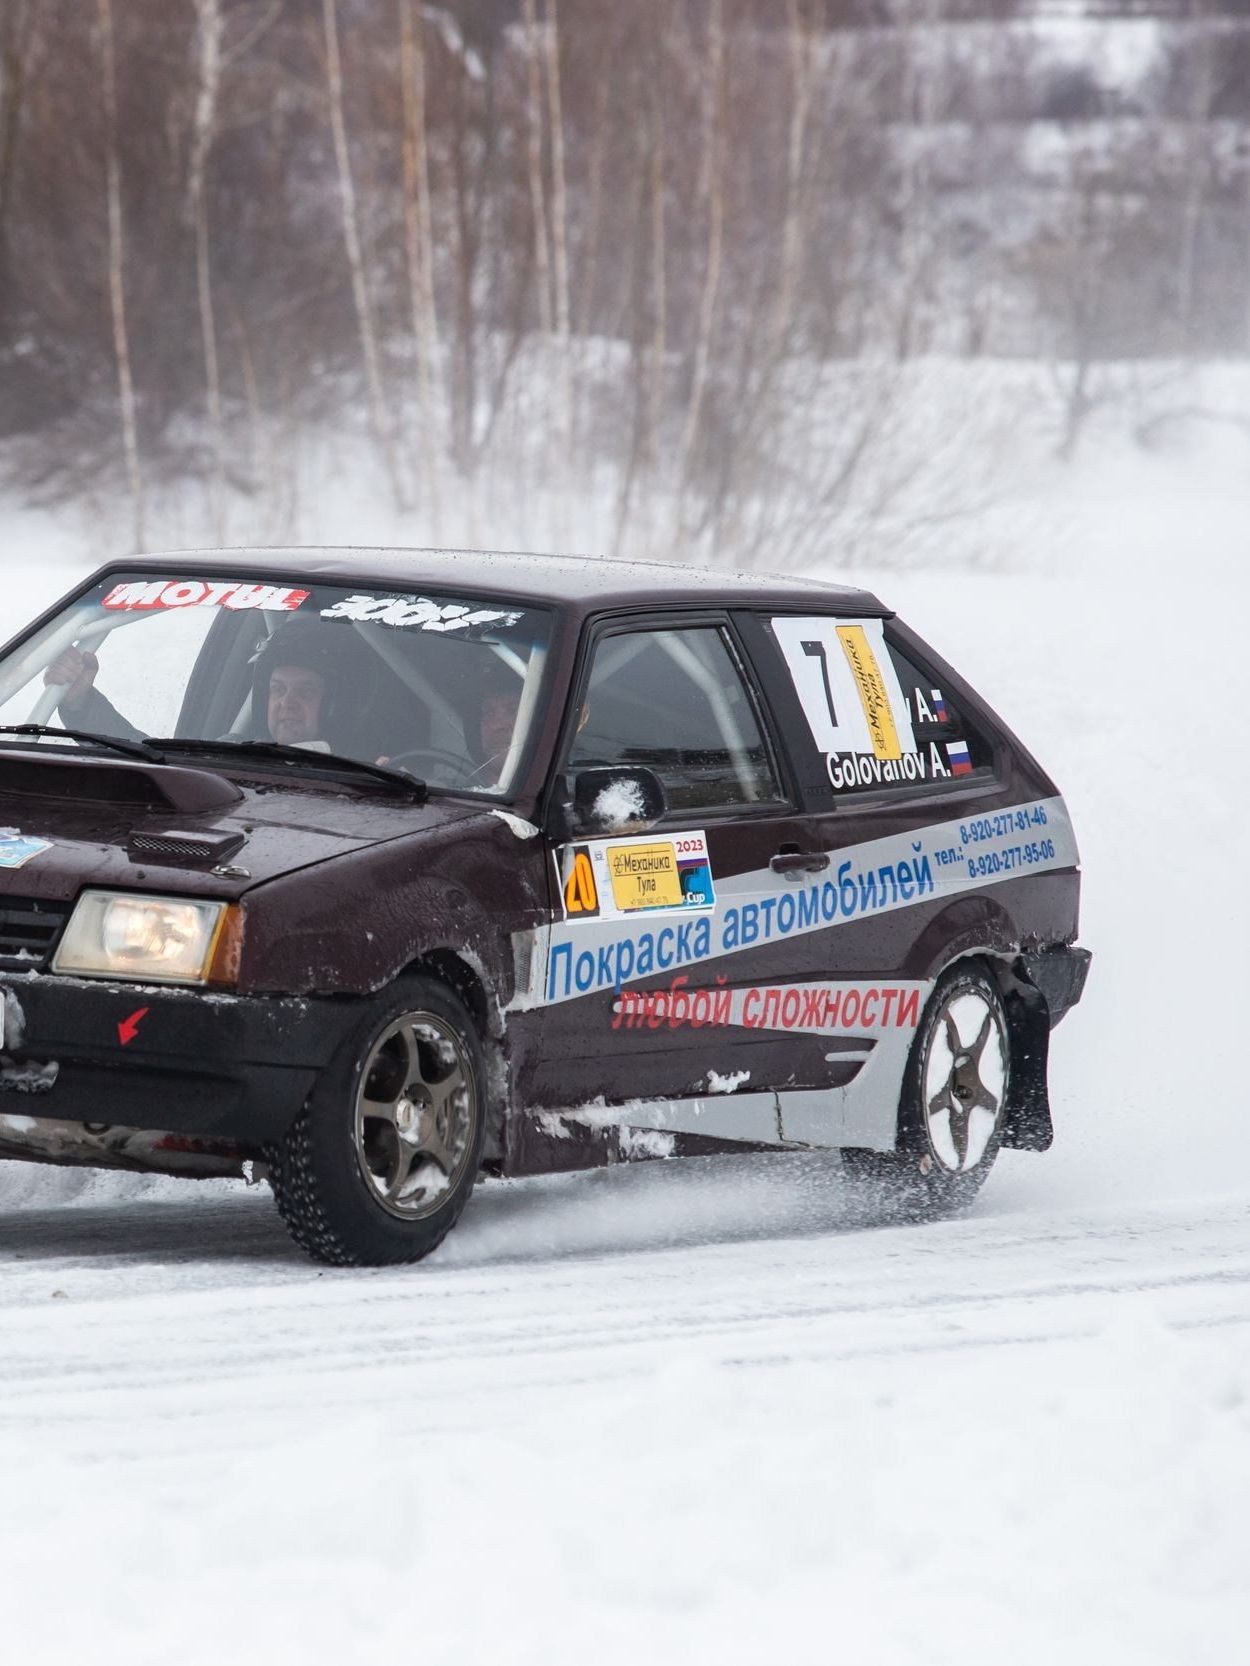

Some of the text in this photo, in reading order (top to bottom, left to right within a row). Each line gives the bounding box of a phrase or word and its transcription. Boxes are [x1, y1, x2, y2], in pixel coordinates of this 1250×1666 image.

[104, 581, 302, 611] MOTUL
[800, 641, 838, 727] 7
[915, 687, 938, 723] A.
[826, 742, 951, 789] Golovanov A.
[960, 805, 1047, 845] 8-920-277-81-46
[624, 855, 670, 873] Механика
[676, 839, 704, 853] 2023
[967, 838, 1055, 878] 8-920-277-95-06
[637, 876, 657, 896] Тула
[686, 891, 706, 905] Cup
[549, 841, 934, 1000] Покраска автомобилей
[612, 974, 732, 1030] любой
